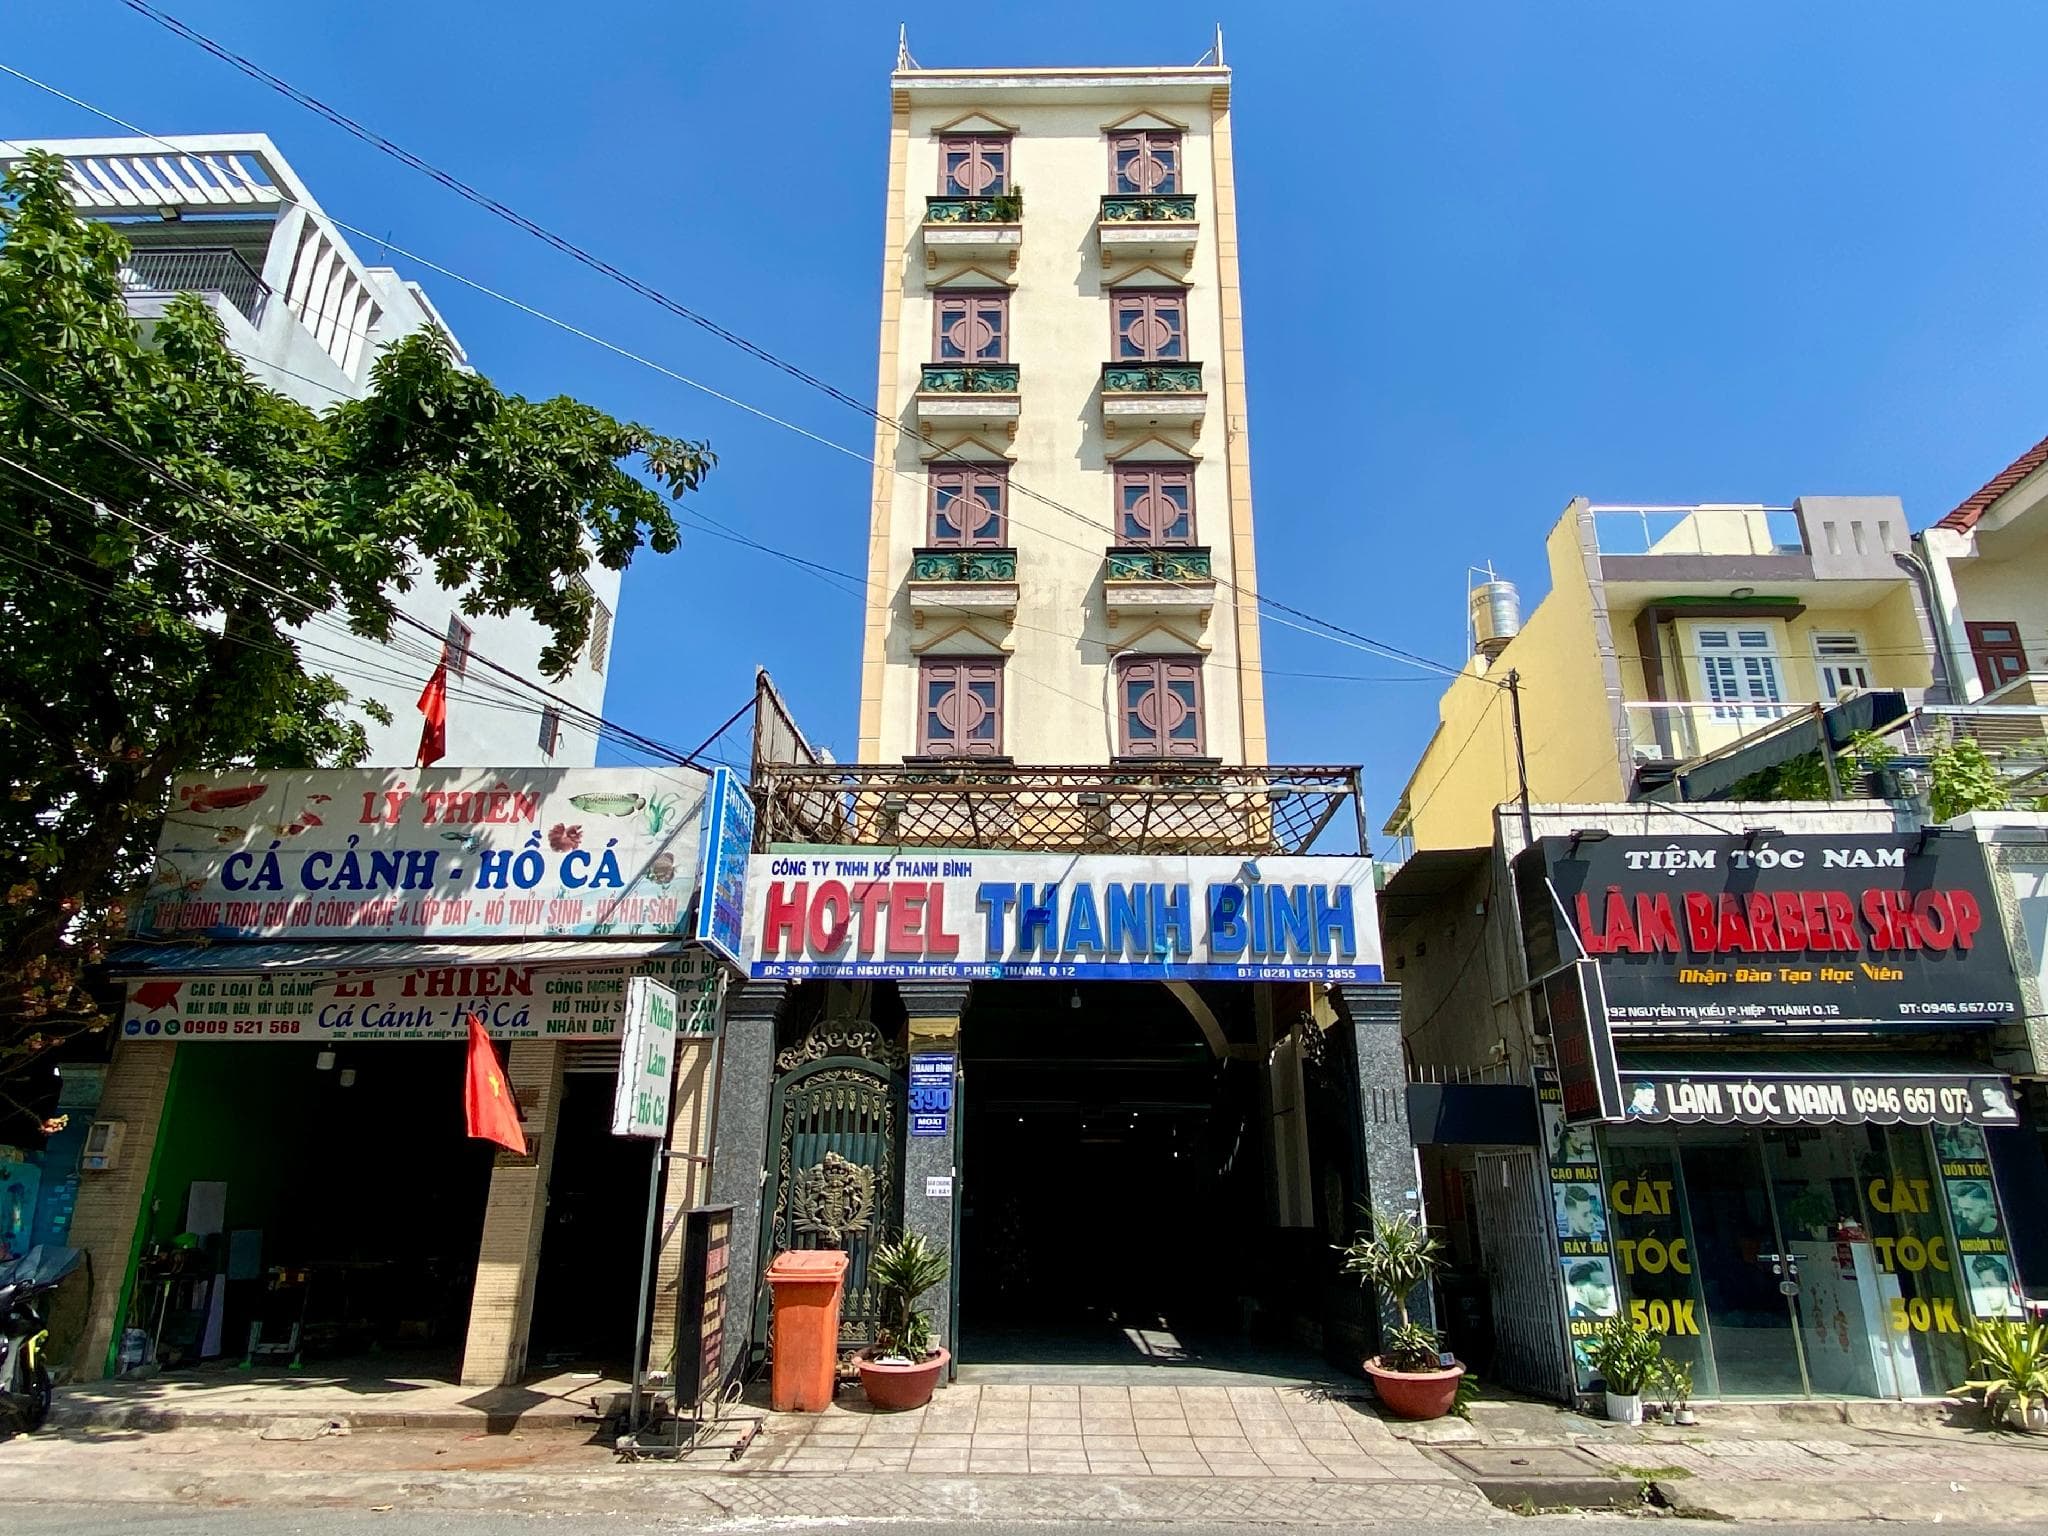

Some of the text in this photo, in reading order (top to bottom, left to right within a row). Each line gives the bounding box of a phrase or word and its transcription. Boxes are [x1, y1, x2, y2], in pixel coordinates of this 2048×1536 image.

[359, 782, 541, 824] LÝ THIÊN
[221, 840, 284, 891] CÁ
[300, 834, 439, 891] CẢNH
[475, 830, 545, 889] HỒ
[560, 838, 625, 888] CÁ
[771, 857, 972, 877] CÔNG TY TNHH KS THANH BÌNH
[1624, 842, 1905, 876] TIỆM TÓC NAM
[181, 897, 221, 927] CÔNG
[225, 902, 260, 928] TRỌN
[264, 897, 289, 927] GÓI
[316, 897, 354, 927] CÔNG
[357, 896, 398, 931] NGHỆ
[399, 901, 408, 926] 4
[412, 891, 439, 924] LỚP
[442, 894, 472, 924] ĐÁY
[509, 891, 545, 924] THỦY
[547, 898, 583, 924] SINH
[764, 879, 960, 954] HOTEL
[977, 882, 1193, 955] THANH
[1206, 861, 1357, 957] BÌNH
[1683, 890, 1862, 953] BARBER
[1861, 888, 1982, 951] SHOP
[545, 979, 582, 994] CÔNG
[787, 966, 809, 976] 390
[1260, 969, 1290, 978] (028)
[1294, 969, 1323, 978] 6255
[1327, 969, 1356, 978] 3855
[1679, 962, 1904, 986] Nhận Đào Tạo Học Viên
[221, 983, 252, 998] LOẠI
[575, 994, 609, 1013] THỦY
[184, 1020, 228, 1034] 0909
[233, 1020, 263, 1034] 521
[269, 1020, 300, 1034] 568
[318, 1003, 355, 1028] Cá
[361, 1002, 434, 1028] Cảnh
[493, 1002, 530, 1028] Cá
[546, 1017, 587, 1035] NHẬN
[910, 1089, 952, 1110] 390
[1726, 1078, 1781, 1114] TÓC
[1784, 1084, 1847, 1114] NAM
[1852, 1087, 1901, 1113] 0946
[1903, 1088, 1935, 1113] 667
[1940, 1088, 1973, 1114] 073
[1611, 1169, 1673, 1215] CẮT
[1868, 1168, 1929, 1214] CẮT
[1616, 1229, 1691, 1275] TÓC
[1875, 1228, 1950, 1273] TÓC
[1630, 1299, 1700, 1336] 50K
[1889, 1297, 1960, 1334] 50K
